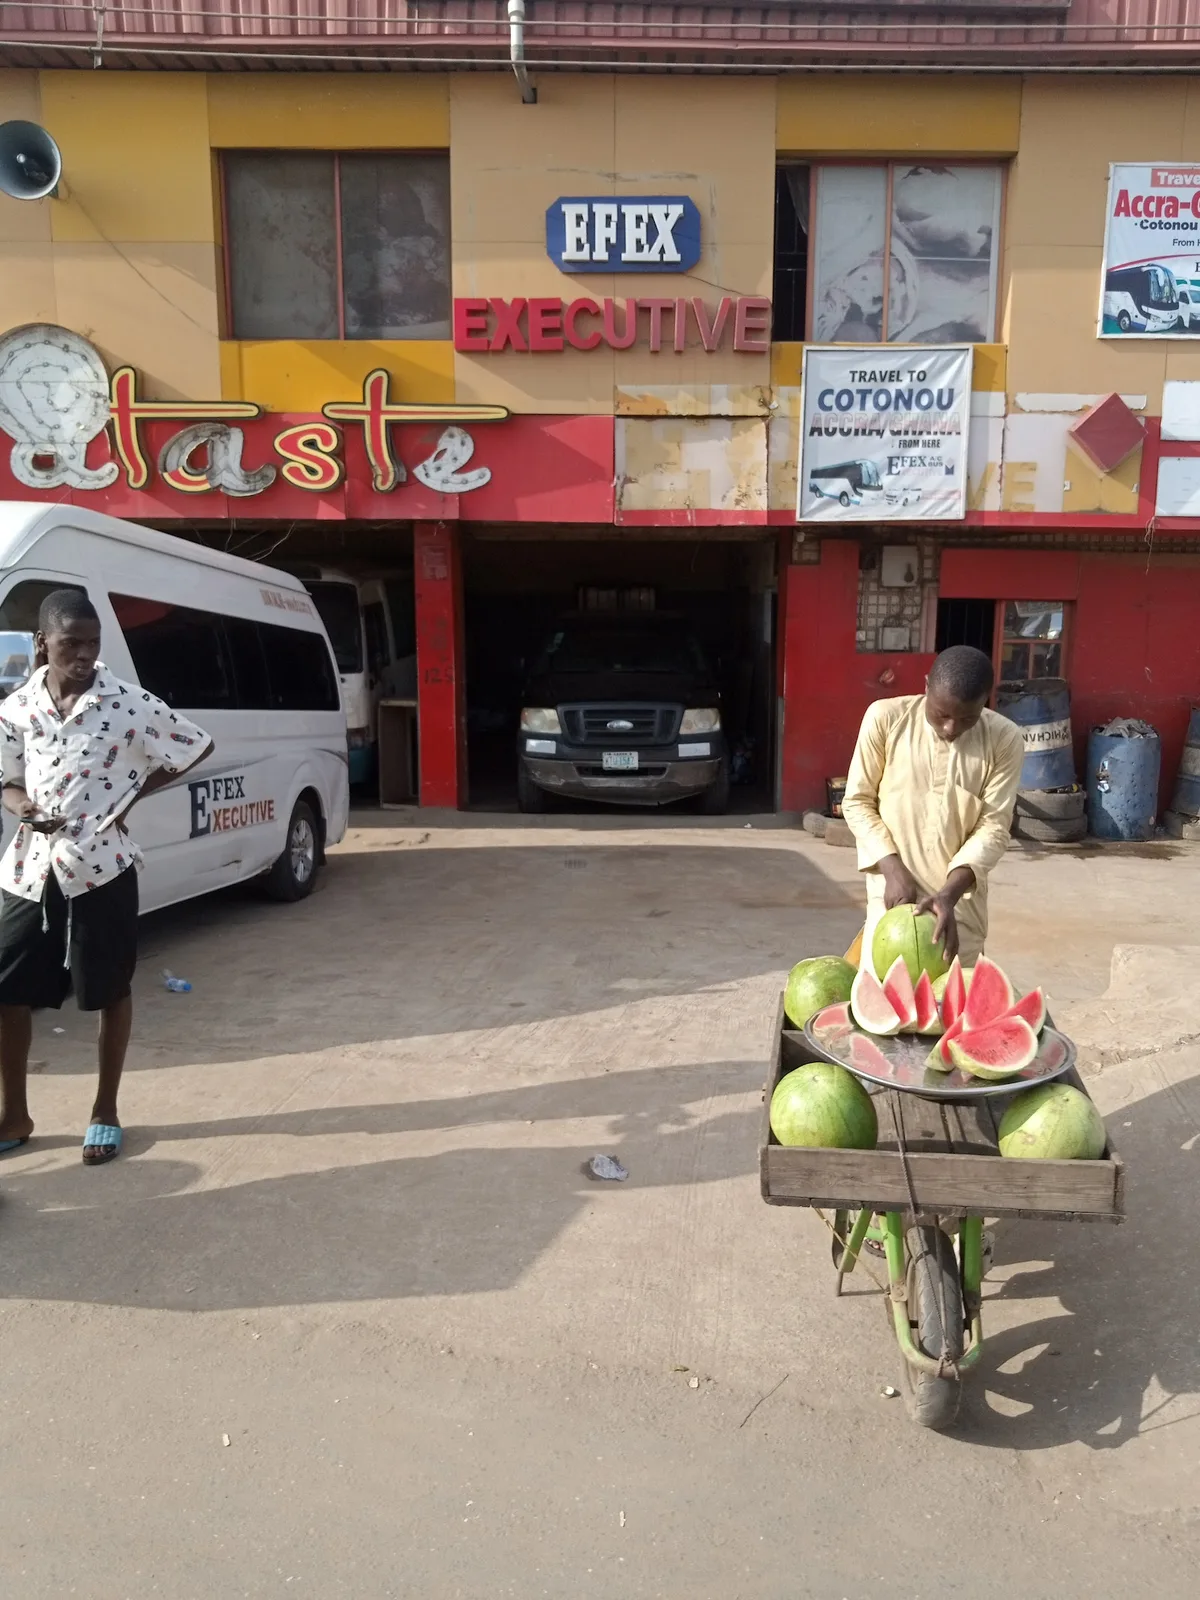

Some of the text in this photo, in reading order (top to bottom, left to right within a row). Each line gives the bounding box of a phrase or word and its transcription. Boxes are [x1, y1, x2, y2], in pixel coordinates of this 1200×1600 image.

[561, 203, 684, 262] EFEX
[1140, 219, 1198, 231] Cotonou
[1173, 239, 1194, 247] From
[453, 297, 772, 353] EXECUTIVE
[849, 370, 927, 383] TRAVEL TO
[817, 388, 955, 412] COTONOU
[898, 439, 941, 449] FROM HERE
[886, 456, 927, 476] EFEX
[188, 776, 245, 839] EFEX
